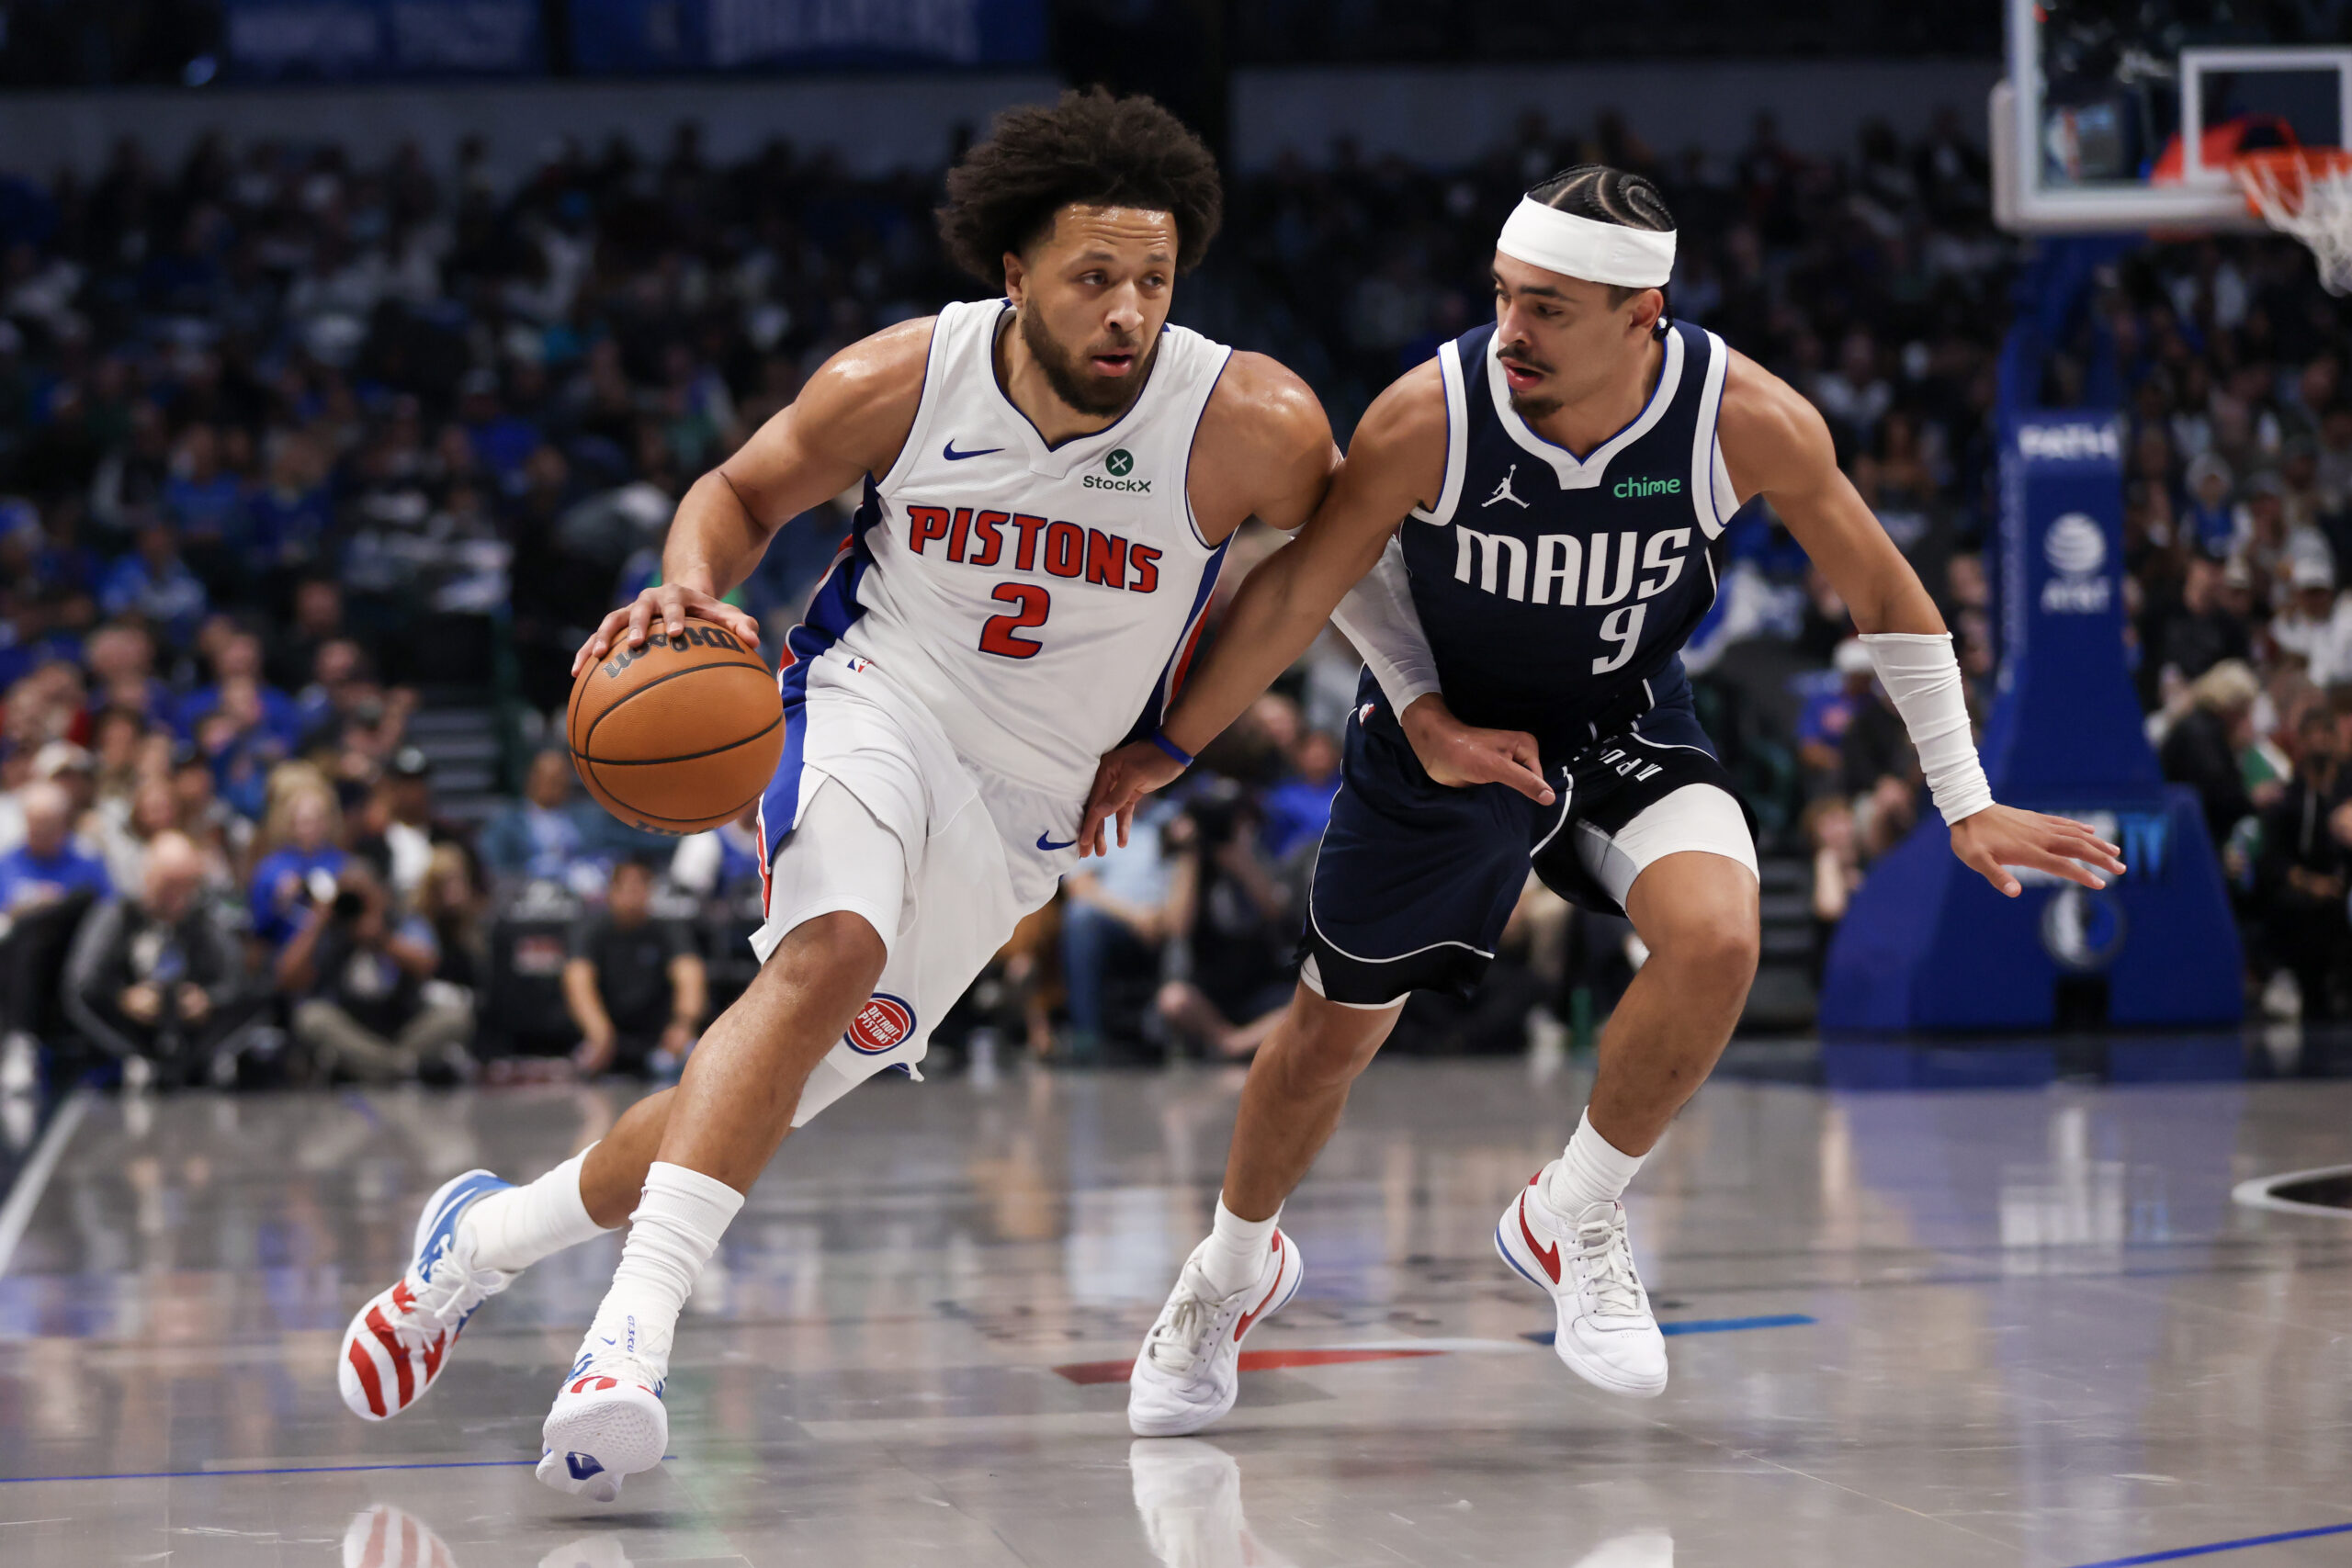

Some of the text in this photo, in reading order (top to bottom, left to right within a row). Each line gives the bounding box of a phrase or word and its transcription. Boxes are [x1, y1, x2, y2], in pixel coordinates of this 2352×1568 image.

[1082, 475, 1152, 494] StockX
[1612, 476, 1681, 499] chime
[906, 504, 1163, 594] PISTONS
[1453, 524, 1692, 607] MAVS
[978, 581, 1051, 660] 2
[1591, 602, 1648, 675] 9
[857, 1010, 892, 1044] PISTONS
[867, 1004, 901, 1037] DETROIT
